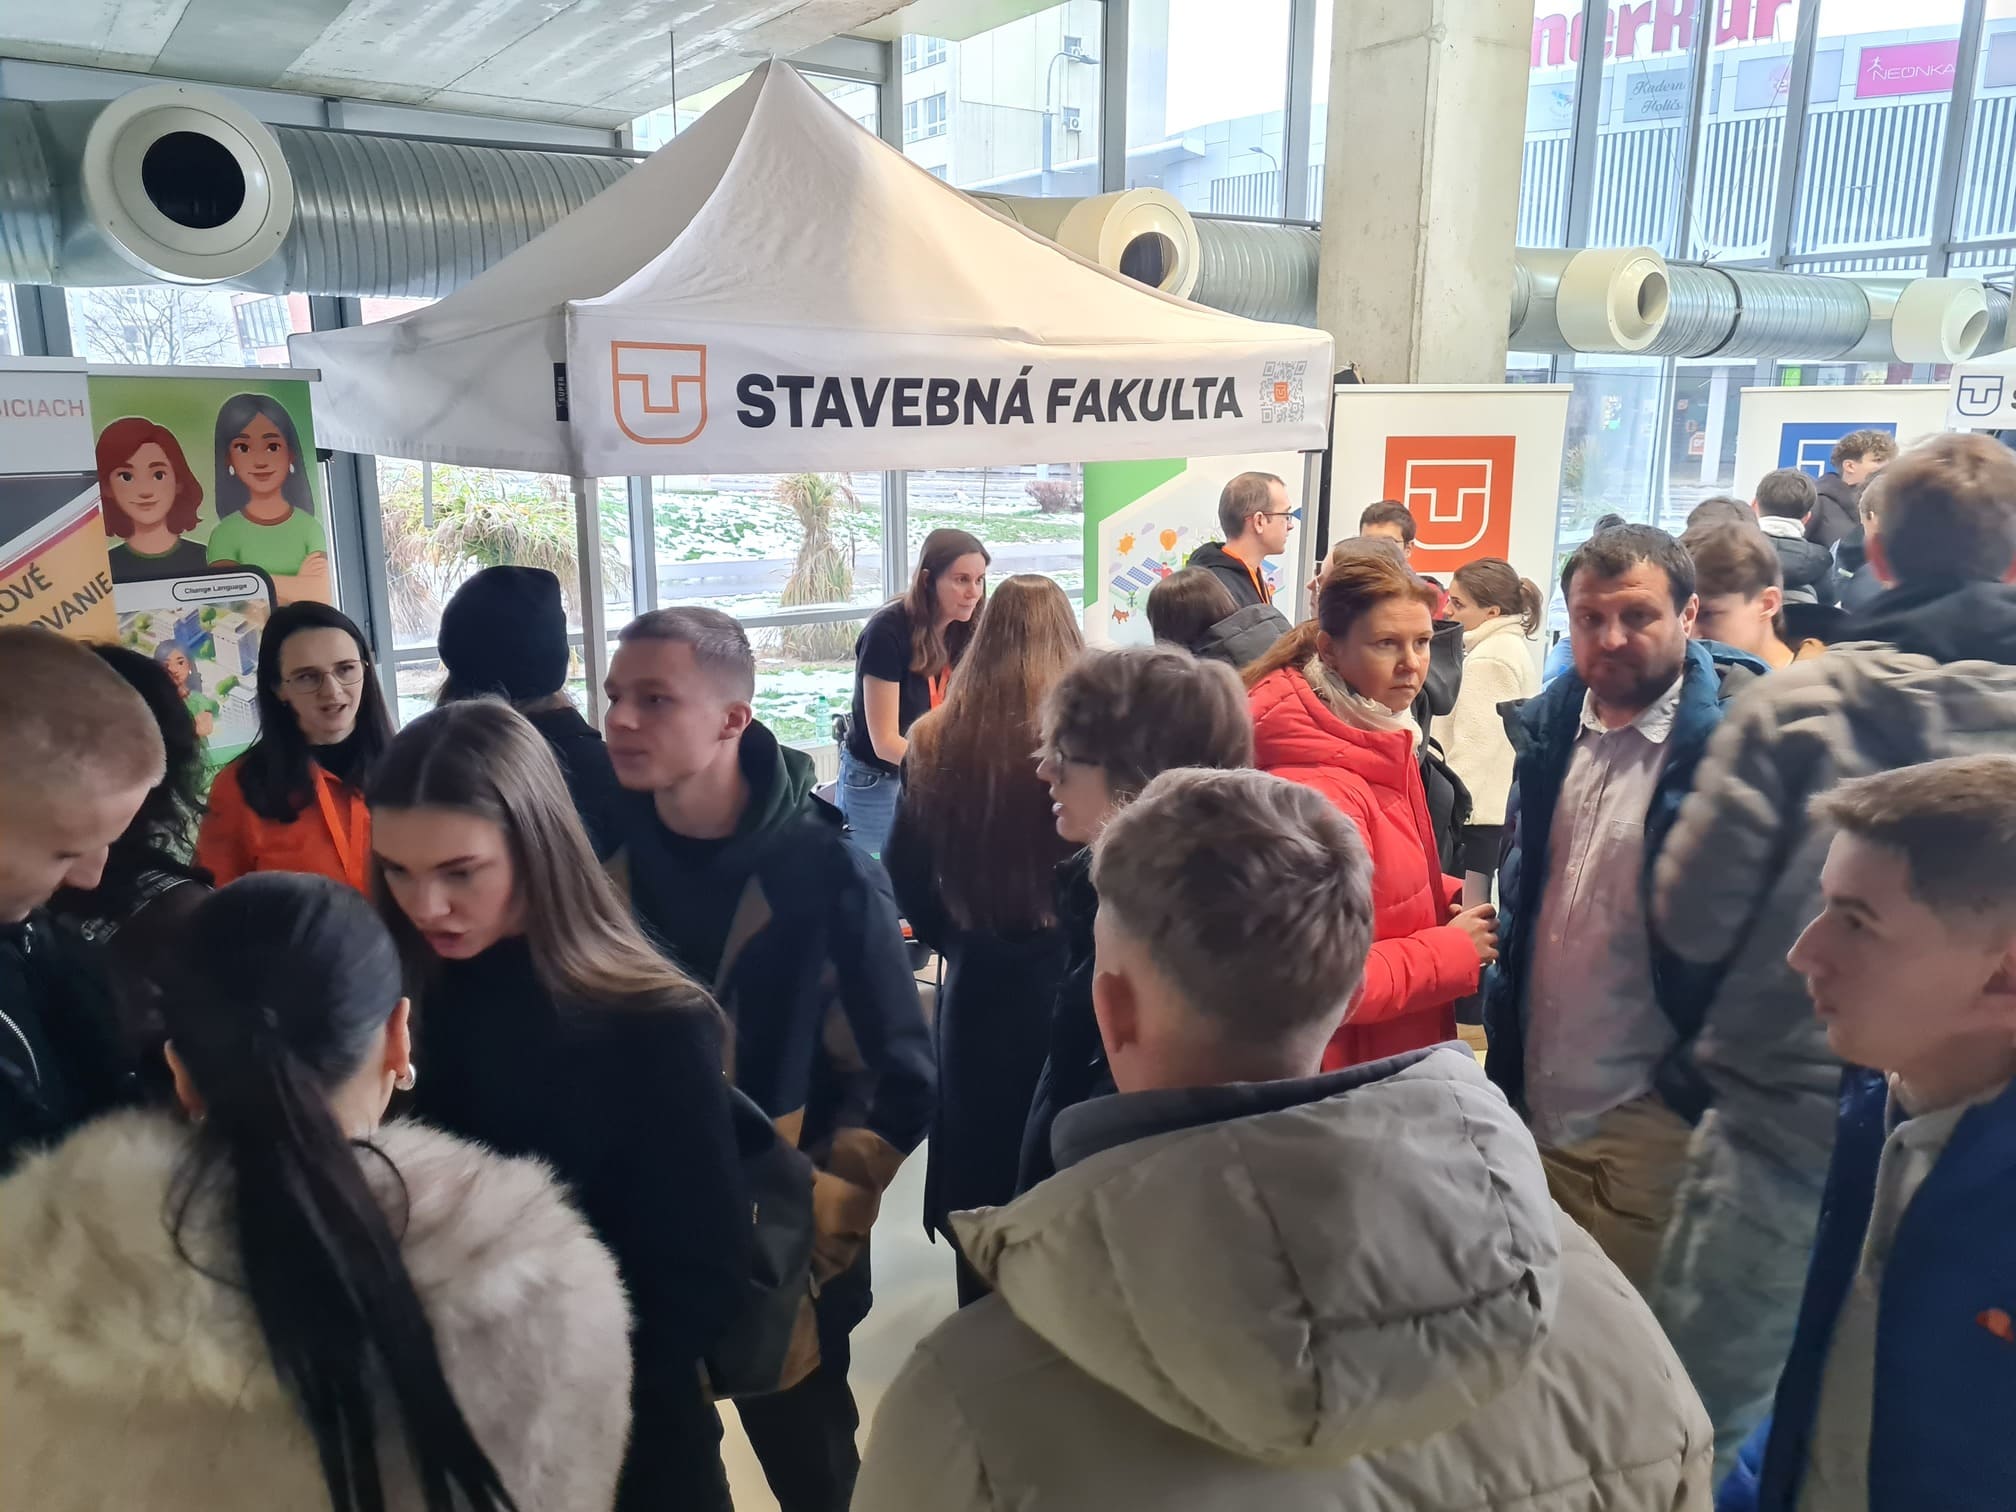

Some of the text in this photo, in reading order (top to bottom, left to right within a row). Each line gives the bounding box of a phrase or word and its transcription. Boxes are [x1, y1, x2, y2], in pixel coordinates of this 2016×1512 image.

[1632, 79, 1686, 95] Kadern
[736, 366, 1244, 428] STAVEBNÁ FAKULTA
[0, 399, 84, 417] ICIACH
[0, 562, 53, 616] OVÉ
[212, 584, 247, 592] Language
